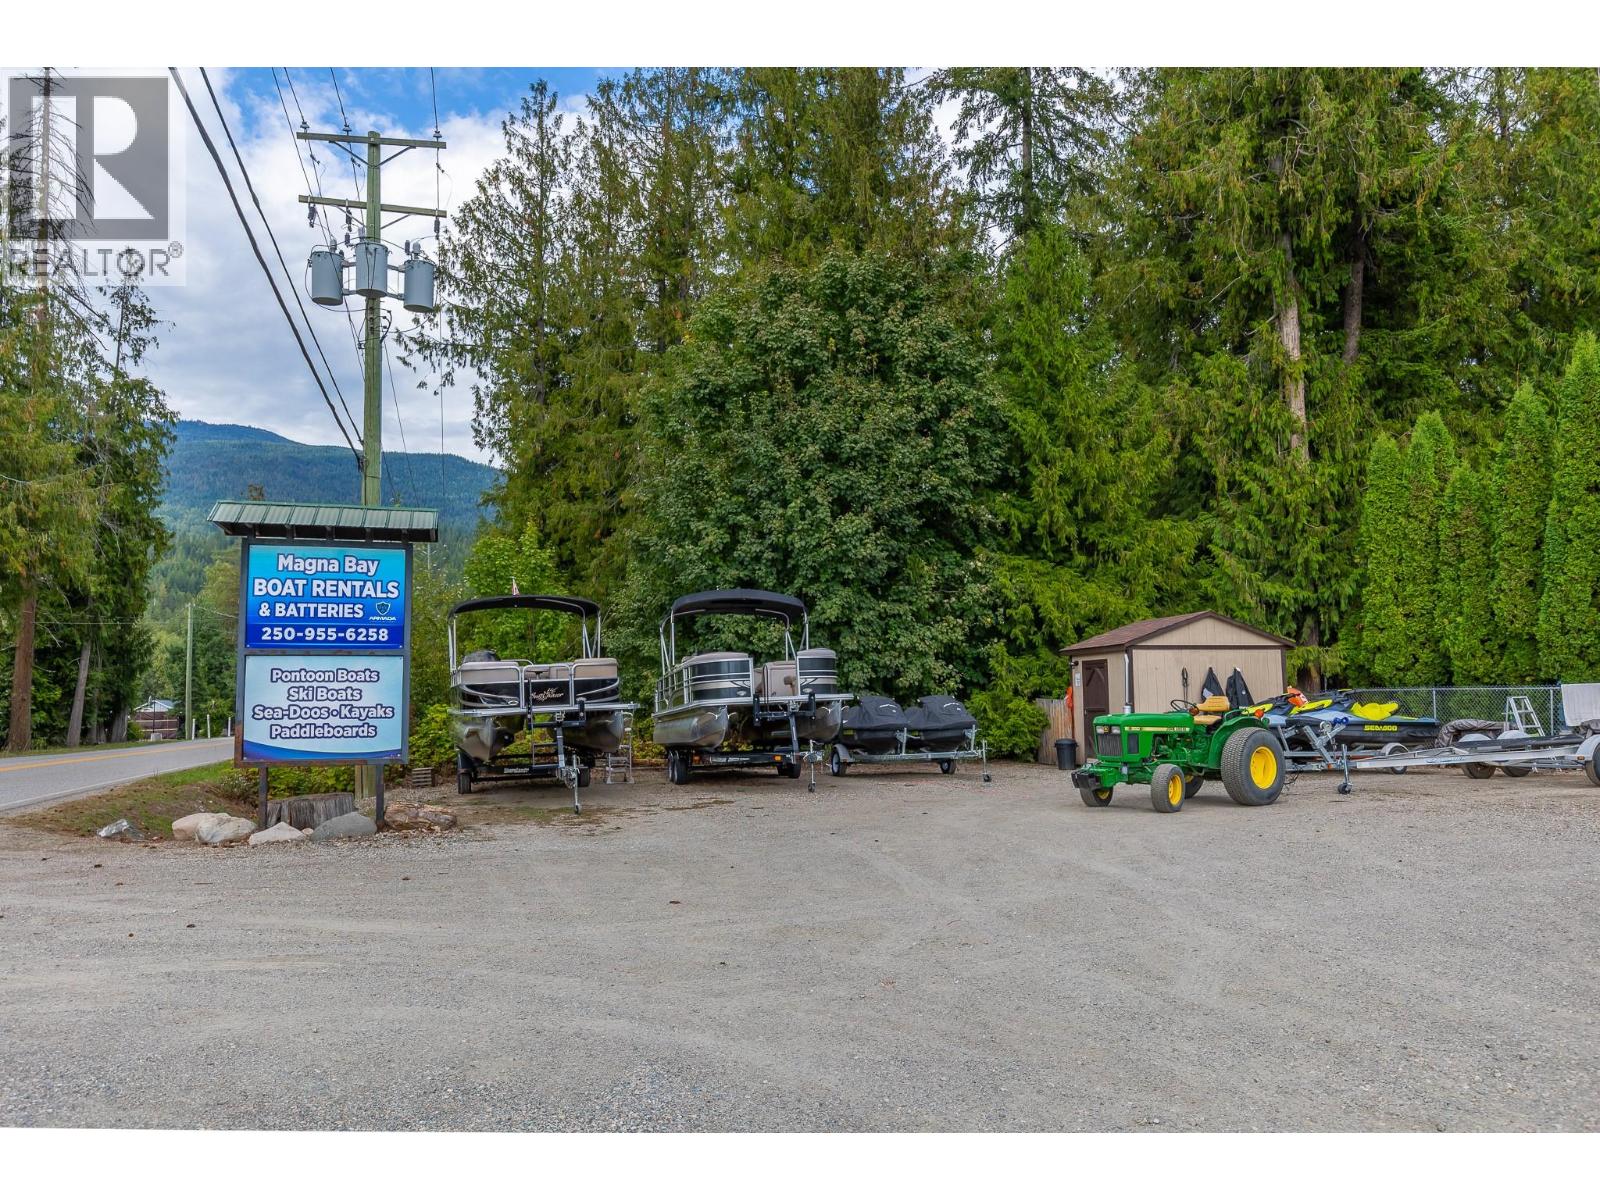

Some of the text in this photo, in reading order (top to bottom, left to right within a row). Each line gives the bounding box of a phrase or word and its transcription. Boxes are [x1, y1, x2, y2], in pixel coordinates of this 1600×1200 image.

[277, 554, 379, 576] Magna Bay
[253, 578, 400, 599] BOAT RENTALS
[258, 602, 364, 618] & BATTERIES
[261, 627, 389, 642] 250-955-6258
[271, 669, 380, 682] Pontoon Boats
[287, 687, 362, 701] Ski Boats
[252, 704, 394, 720] Sea-Doos Kayaks
[270, 724, 377, 739] Paddleboards
